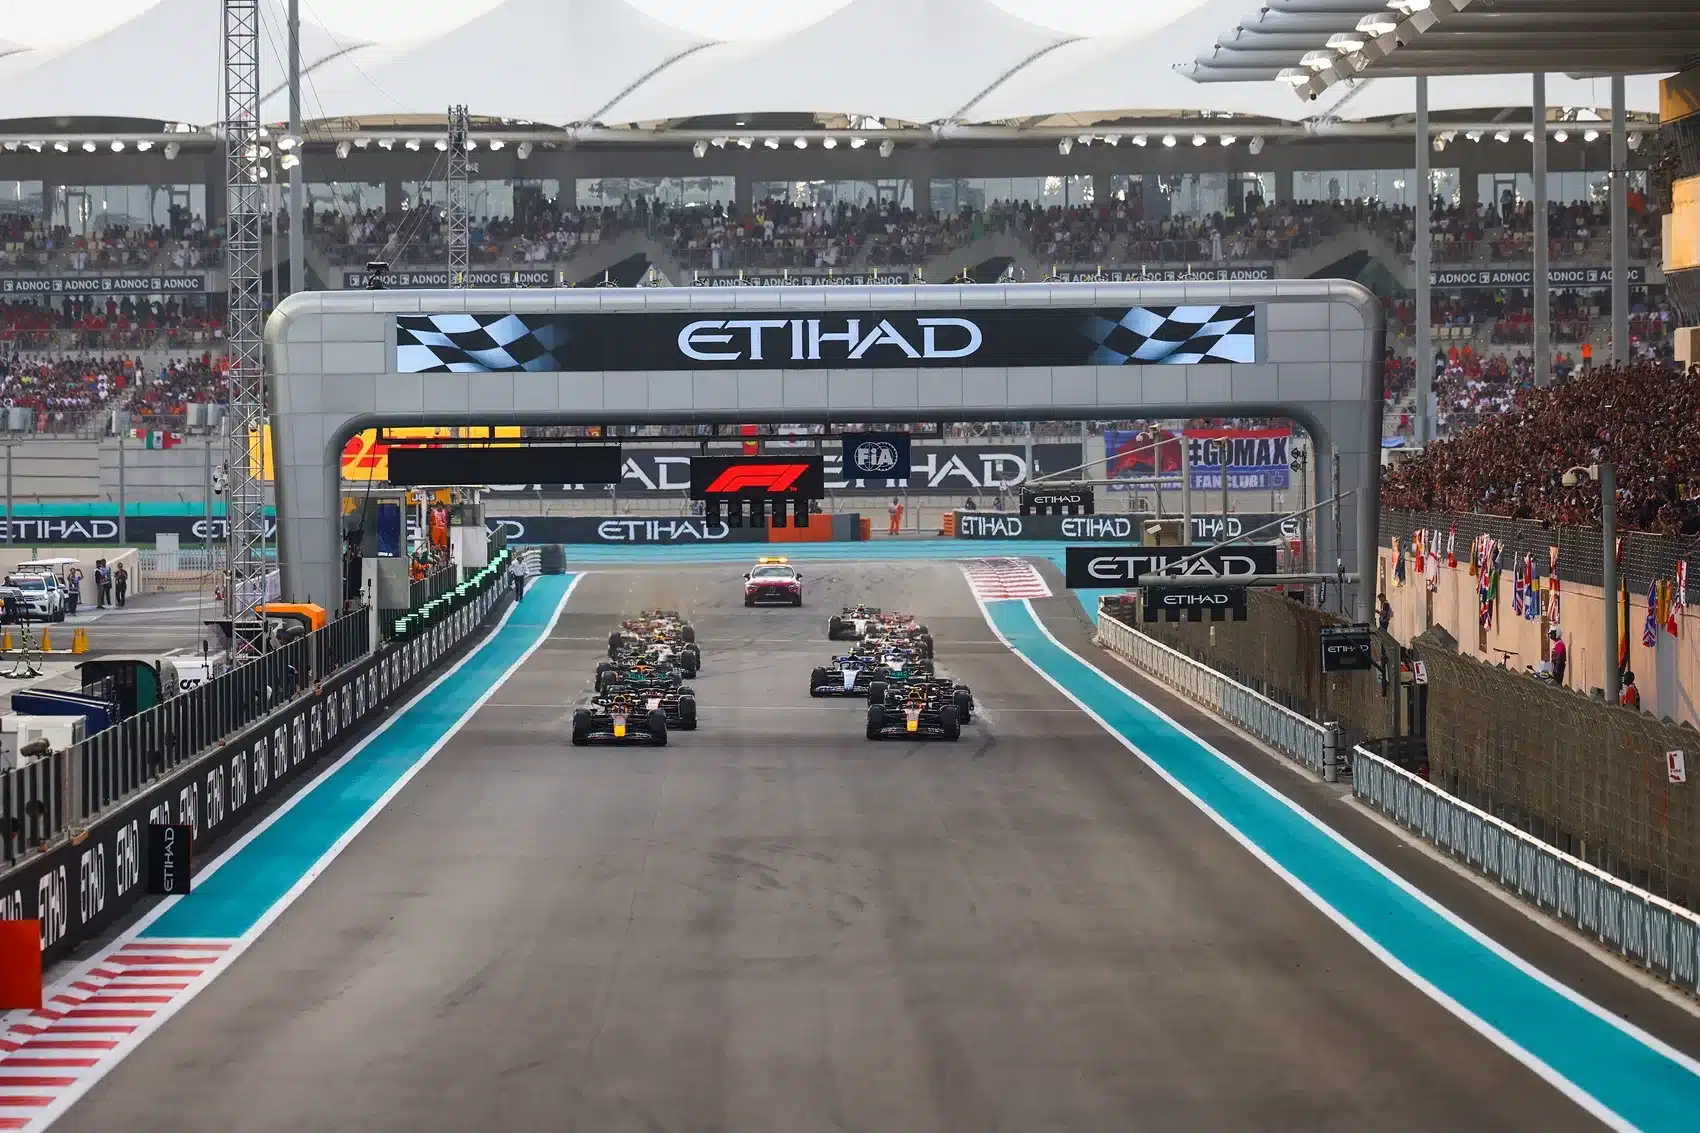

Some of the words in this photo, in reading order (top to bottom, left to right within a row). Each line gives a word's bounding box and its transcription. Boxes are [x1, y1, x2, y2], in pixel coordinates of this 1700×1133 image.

[412, 275, 447, 284] ADNOC
[463, 274, 497, 283] DNOC
[1230, 271, 1267, 280] ADNOC
[1439, 273, 1476, 283] ADNOC
[1493, 272, 1530, 282] ADNOC
[1548, 271, 1583, 281] ADNOC
[16, 283, 50, 291] ADNOC
[65, 282, 99, 290] ADNOC
[114, 280, 148, 289] ADNOC
[164, 279, 198, 288] ADNOC
[678, 318, 982, 360] ETIHAD
[1196, 475, 1221, 488] FAN
[1034, 495, 1081, 504] ETIHAD
[598, 520, 729, 540] ETIHAD
[961, 516, 1022, 536] ETIHAD
[1061, 518, 1131, 537] ETIHAD
[1087, 555, 1257, 579] ETIHAD
[1163, 594, 1229, 605] ETIHAD
[1328, 644, 1369, 653] ETIHD
[163, 827, 175, 892] ETIHAD
